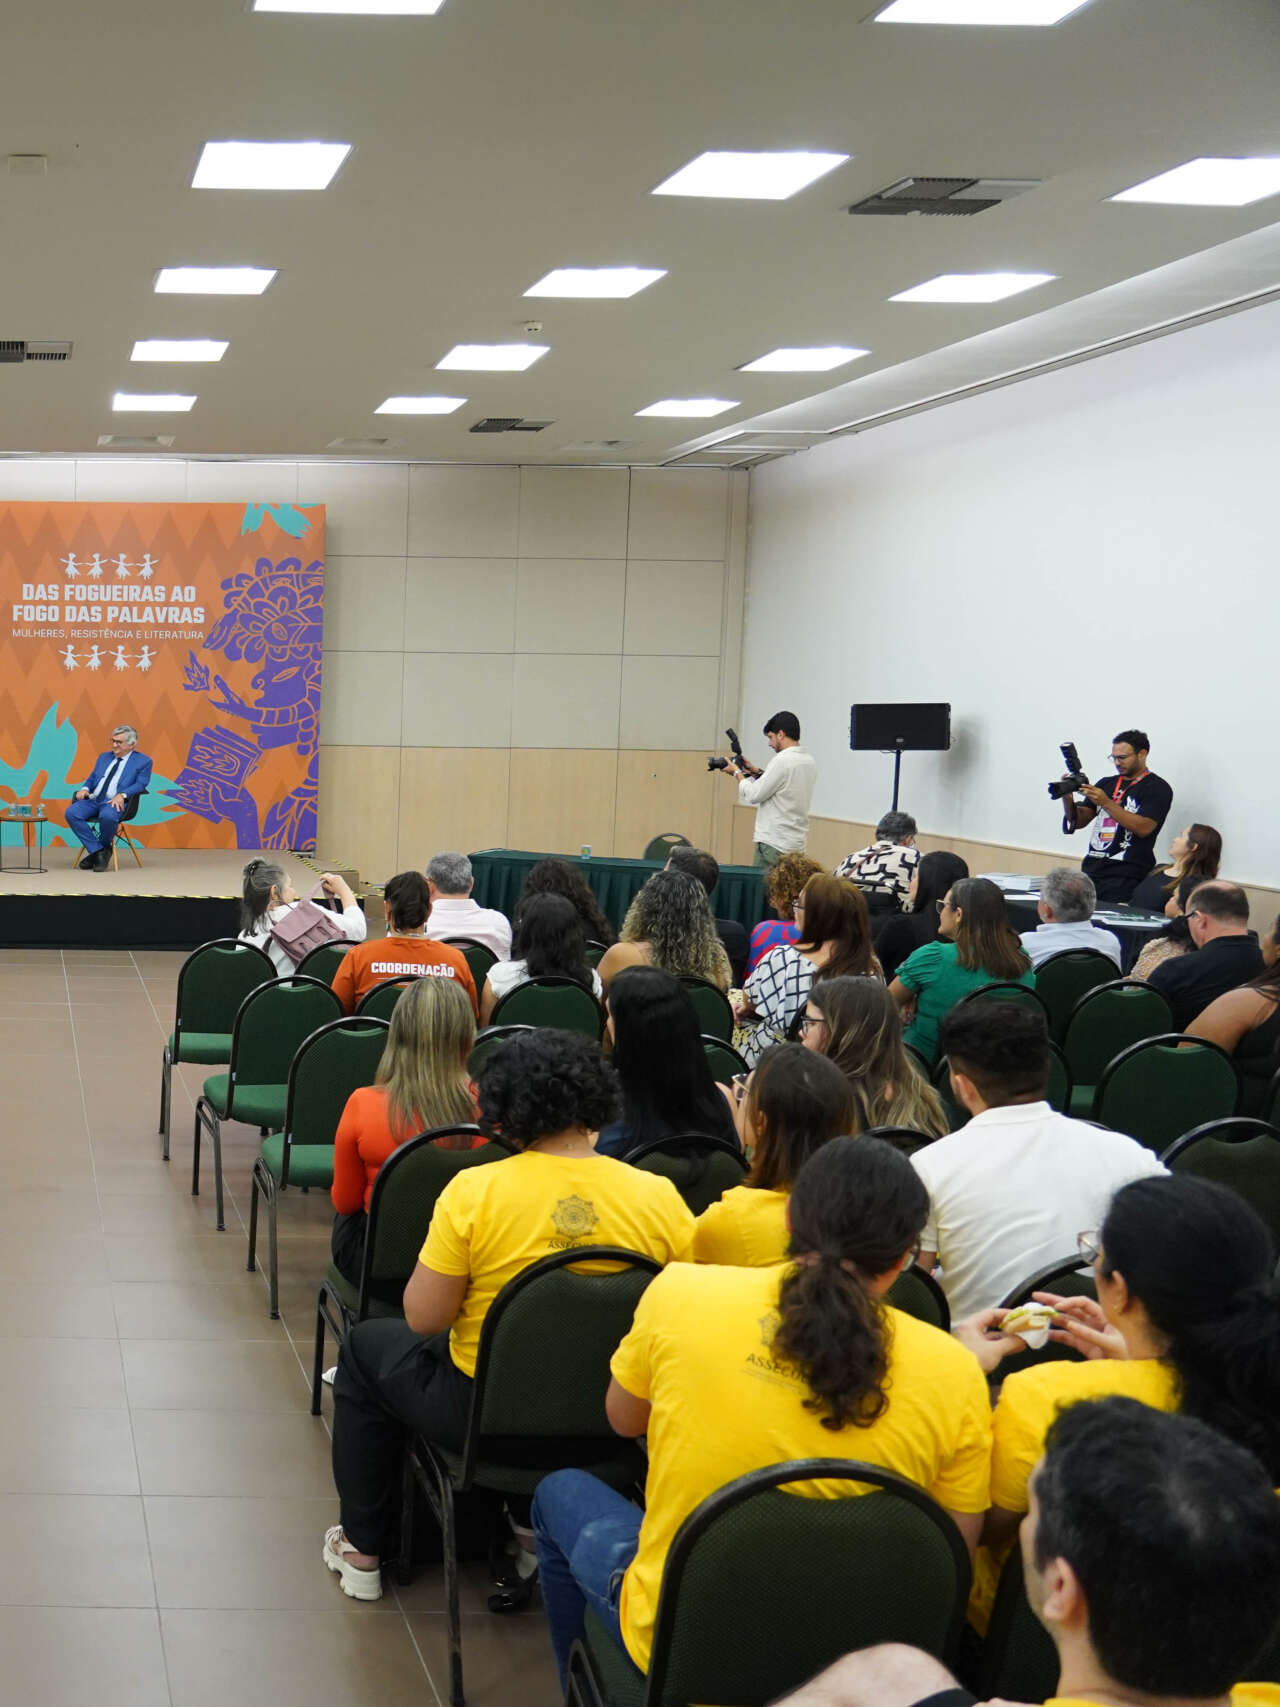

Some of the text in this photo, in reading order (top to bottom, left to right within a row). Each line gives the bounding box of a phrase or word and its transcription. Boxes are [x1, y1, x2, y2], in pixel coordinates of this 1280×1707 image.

[22, 583, 196, 603] DAS FOGUEIRAS AO
[12, 604, 205, 624] FOGO DAS PALAVRAS
[12, 627, 204, 640] MULHERES, RESISTÊNCIA E LITERATURA
[370, 961, 456, 978] COORDENAÇÃO
